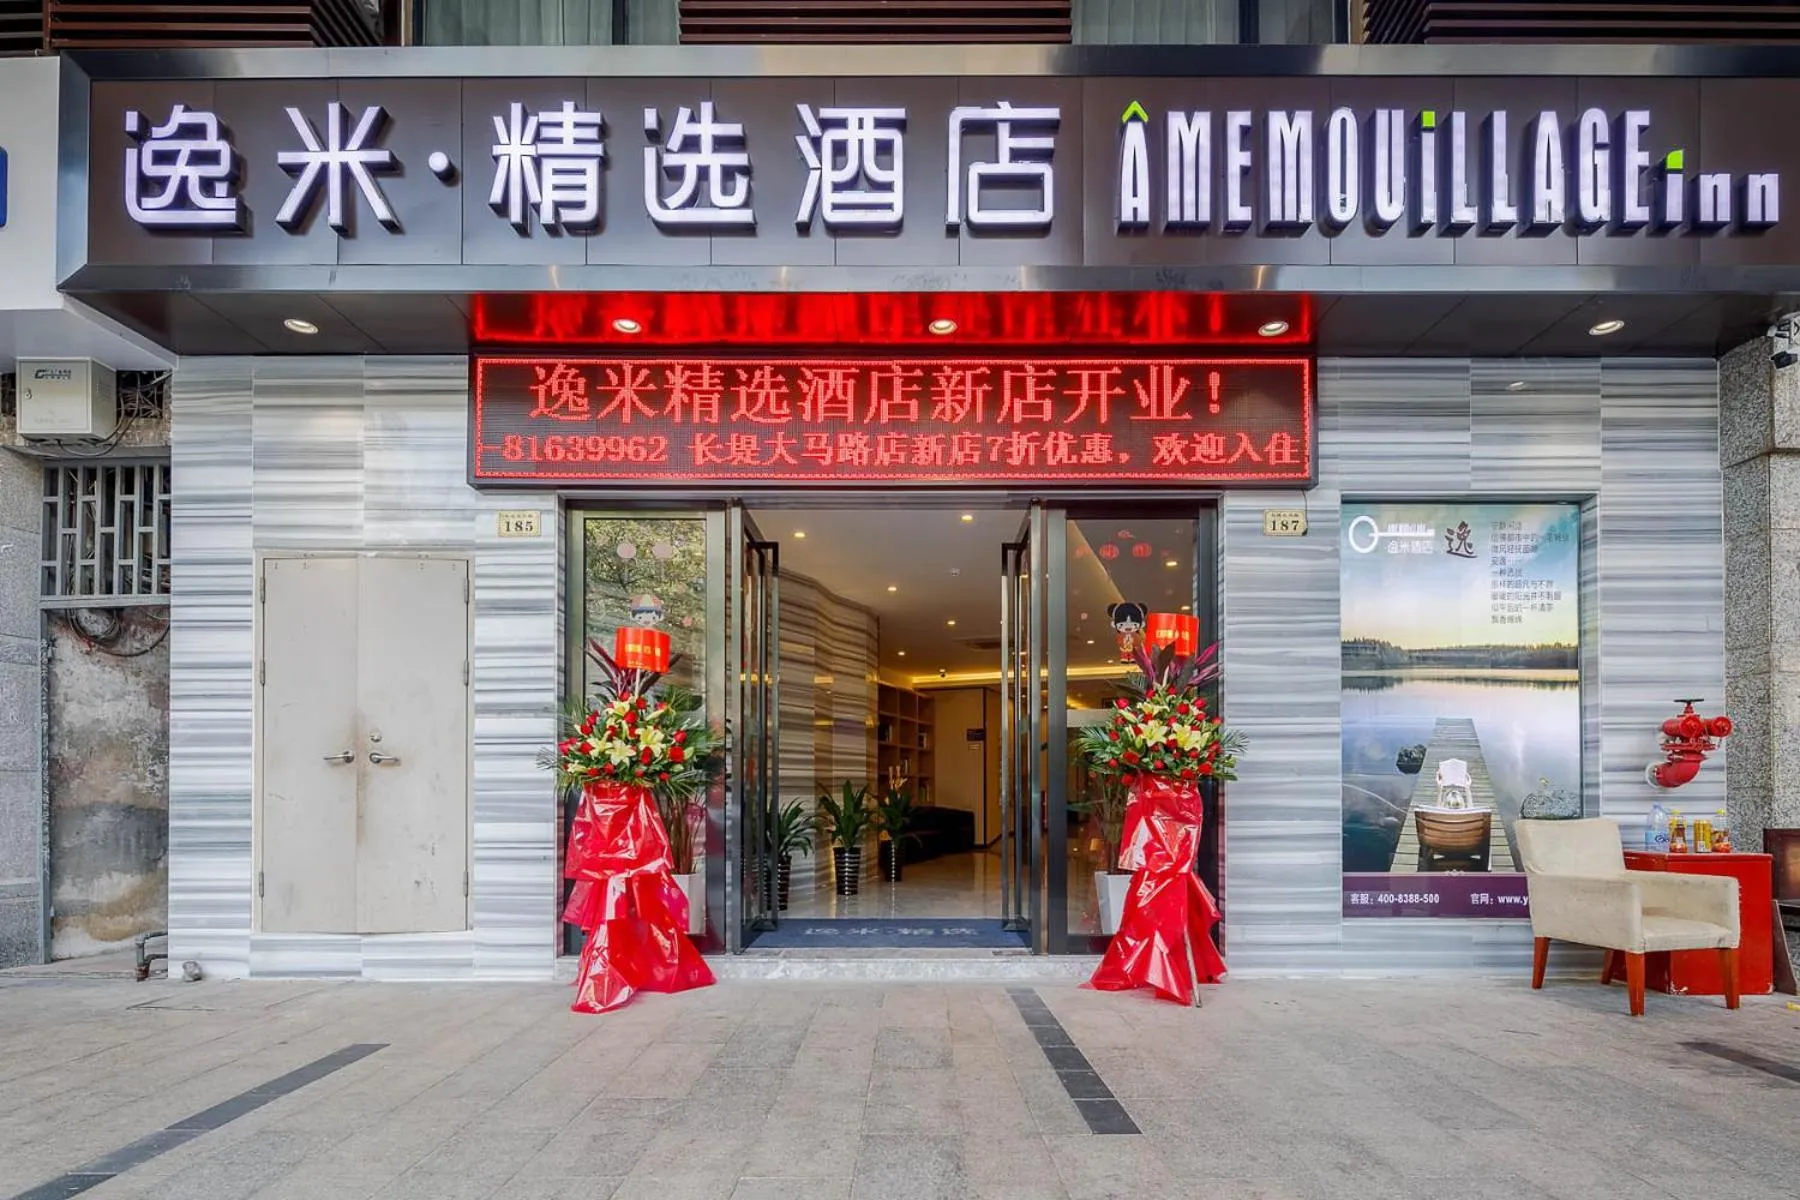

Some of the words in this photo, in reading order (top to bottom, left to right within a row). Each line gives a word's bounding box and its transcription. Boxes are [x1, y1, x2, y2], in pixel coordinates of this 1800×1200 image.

[529, 362, 1220, 424] 逸米精选酒店新店开业!
[506, 520, 533, 532] 185
[1272, 519, 1299, 531] 187
